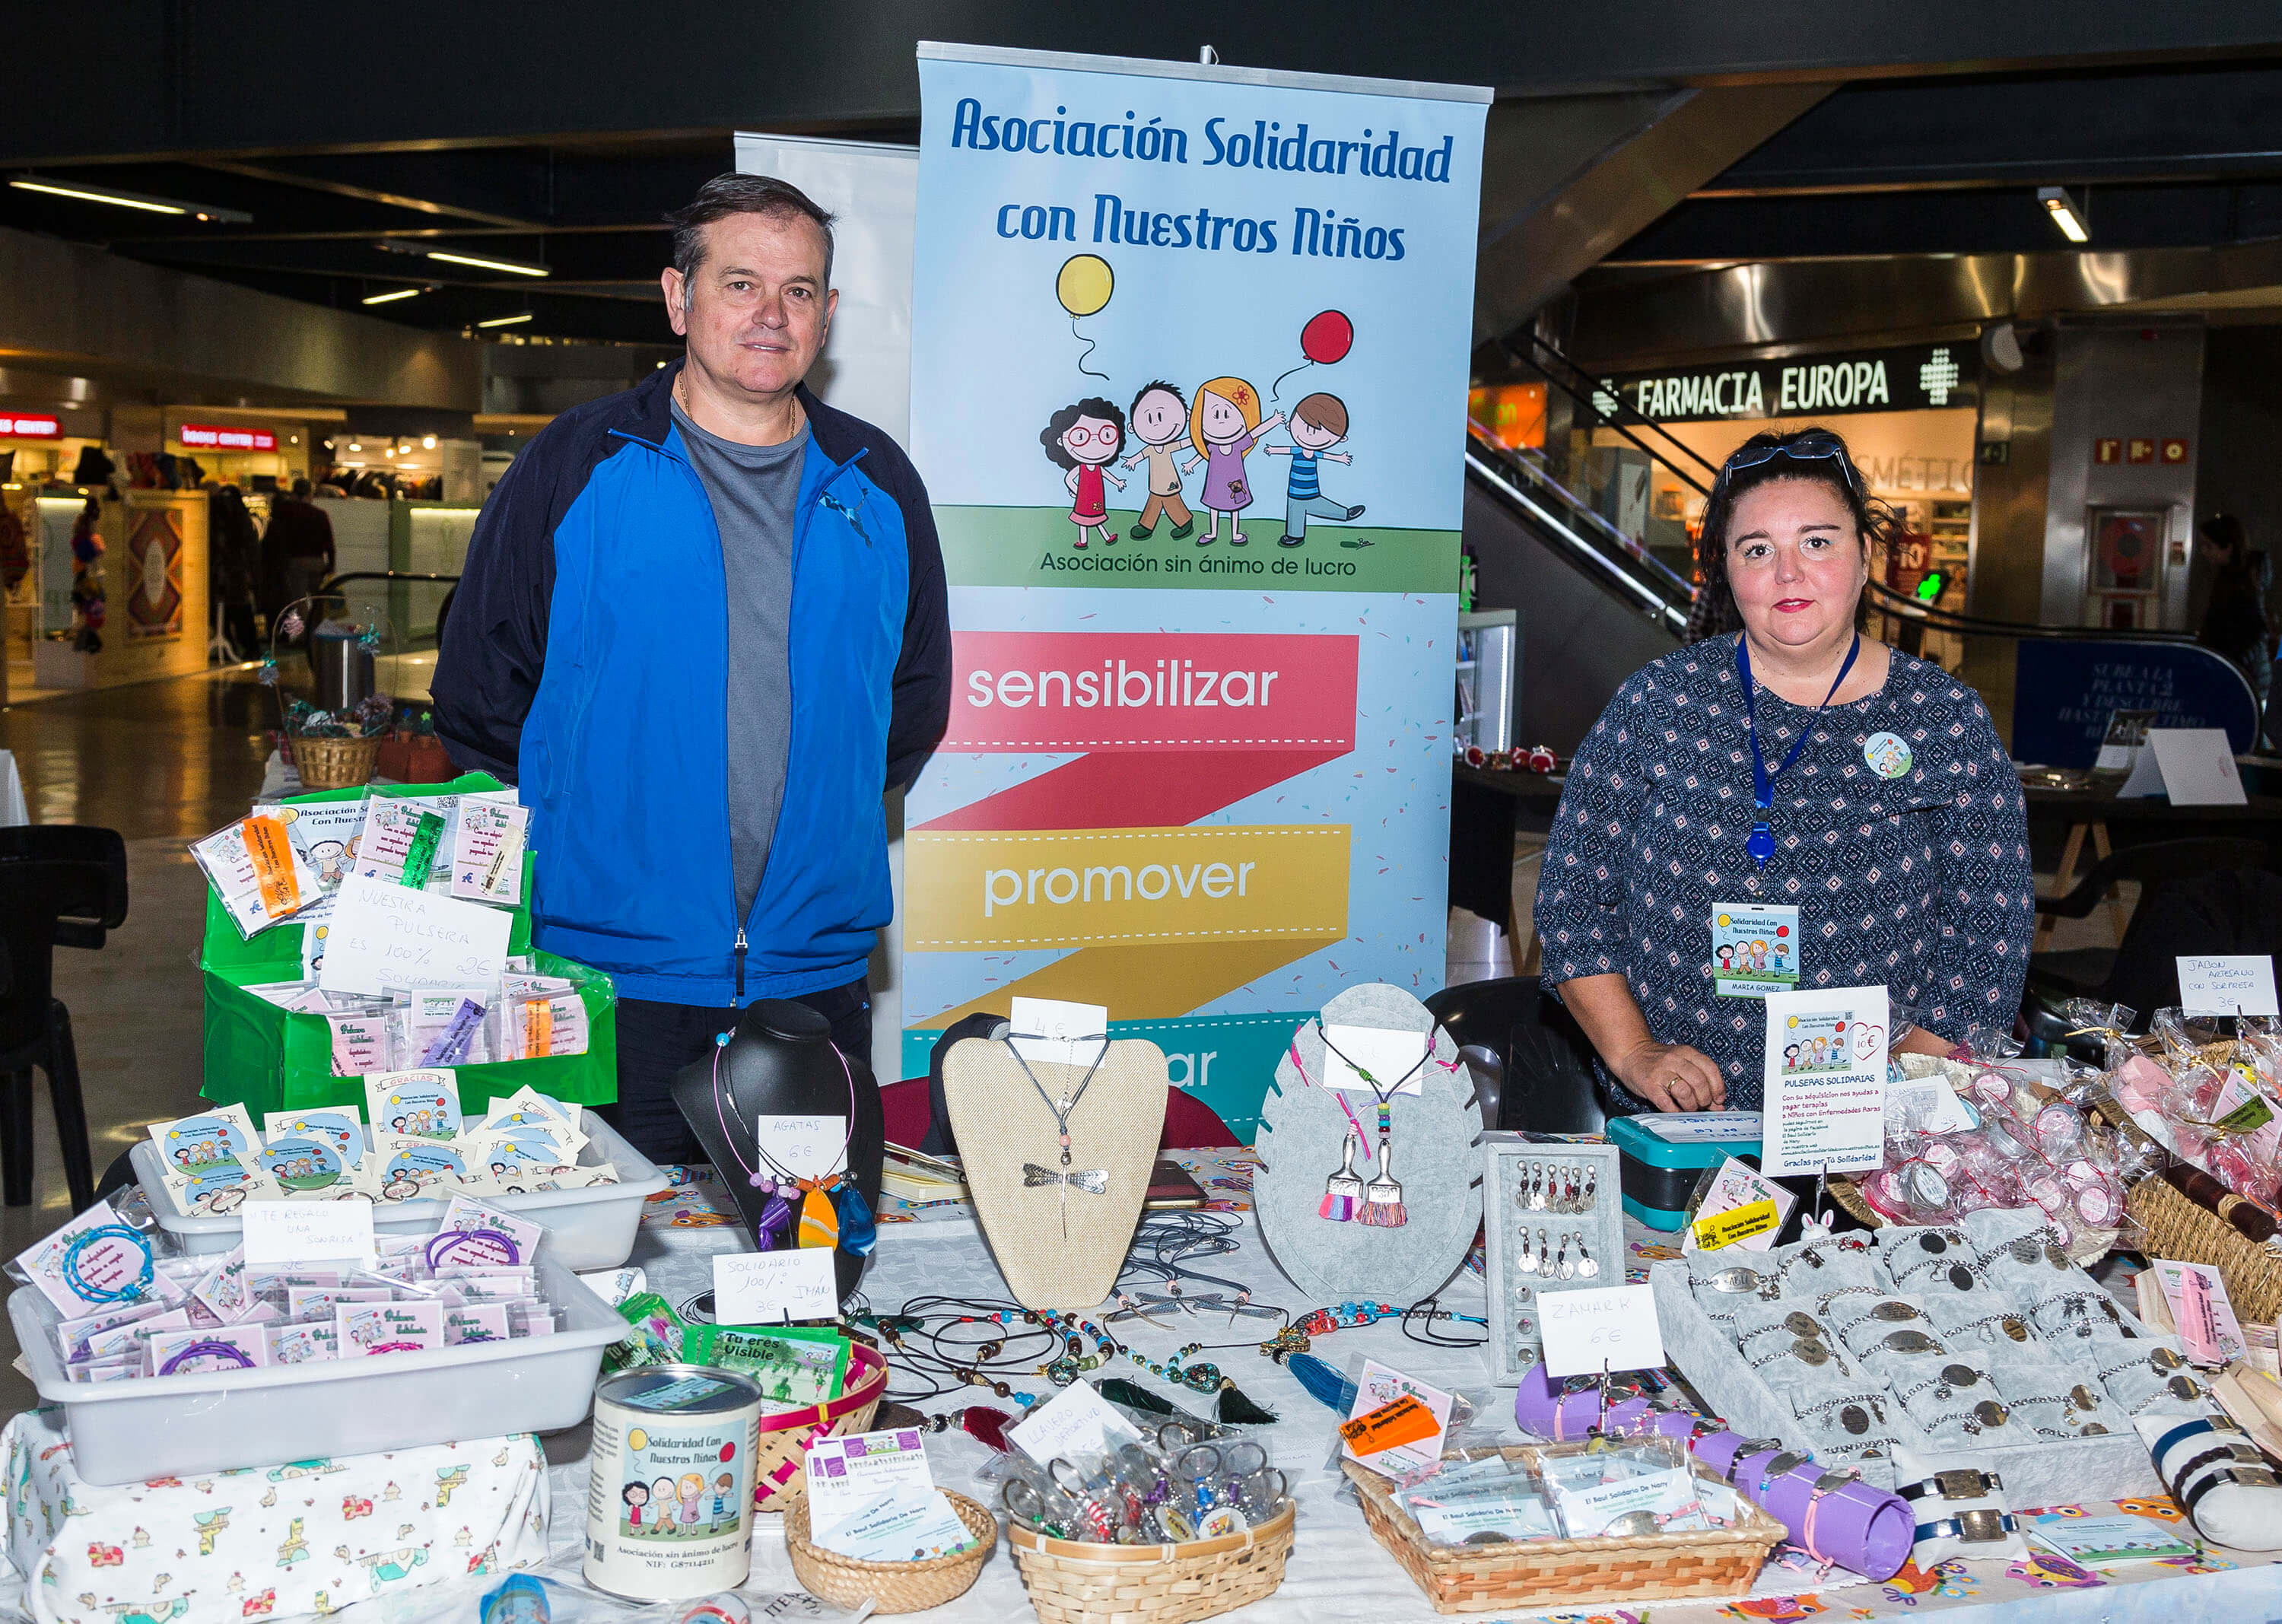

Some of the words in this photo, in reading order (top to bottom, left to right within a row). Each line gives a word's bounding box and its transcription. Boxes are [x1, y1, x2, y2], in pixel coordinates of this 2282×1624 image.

[951, 97, 1187, 164] Asociación
[1203, 117, 1454, 183] Solidaridad
[997, 203, 1076, 241] con
[1093, 194, 1277, 253] Nuestros
[1294, 207, 1406, 261] Niños
[1638, 371, 1763, 418] FARMACIA
[1781, 360, 1889, 410] EUROPA
[1040, 552, 1158, 573] Asociación
[1164, 554, 1193, 573] sin
[1199, 554, 1265, 574] ánimo
[1270, 556, 1299, 575] de
[1305, 557, 1356, 577] lucro
[968, 659, 1278, 708] sensibilizar
[335, 816, 367, 825] Nuestr
[984, 860, 1255, 917] promover
[359, 888, 426, 915] NUESTRA
[386, 915, 469, 945] PULSERA
[350, 938, 367, 950] ES
[2187, 959, 2226, 971] JABON
[1731, 983, 1754, 992] MARIA
[1756, 984, 1781, 993] GOMEZ
[2217, 996, 2236, 1008] 3€
[389, 1074, 434, 1085] GRACIAS
[1785, 1078, 1825, 1088] PULSERAS
[1826, 1074, 1875, 1085] SOLIDARIAS
[773, 1120, 822, 1132] AGATAS
[1784, 1158, 1811, 1168] Gracias
[1813, 1158, 1825, 1167] por
[1826, 1156, 1835, 1165] Tú
[1837, 1153, 1876, 1164] Solidaridad
[287, 1225, 311, 1234] UNA
[726, 1257, 802, 1273] SOLIDARIO
[725, 1332, 749, 1344] Tu
[752, 1337, 780, 1349] eres
[723, 1345, 775, 1361] Visible
[647, 1436, 704, 1448] Solidaridad
[706, 1436, 722, 1448] Con
[650, 1452, 692, 1464] Nuestros
[693, 1451, 718, 1464] Niños
[617, 1545, 663, 1559] Asociación
[666, 1549, 680, 1559] sin
[682, 1548, 710, 1559] ánimo
[711, 1545, 721, 1555] de
